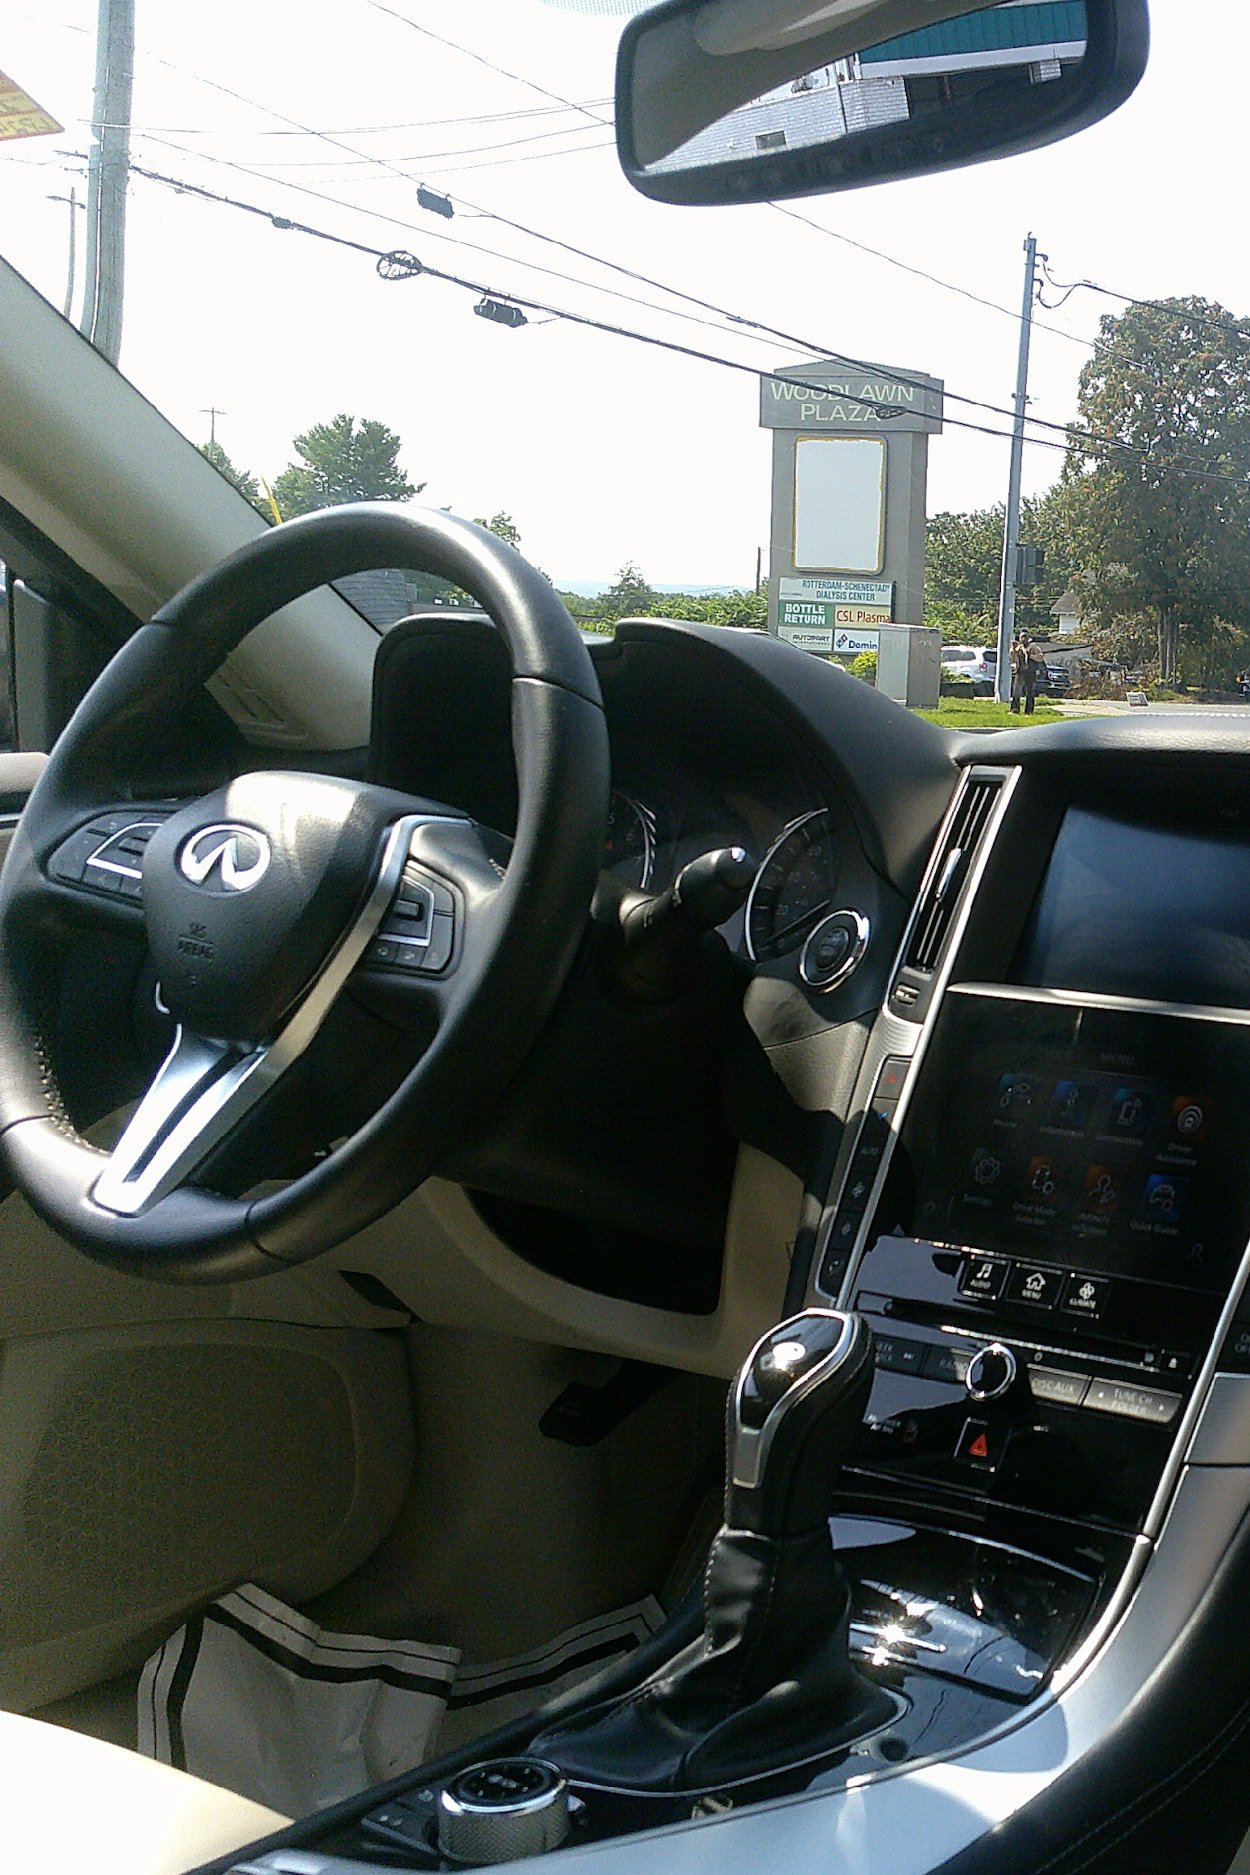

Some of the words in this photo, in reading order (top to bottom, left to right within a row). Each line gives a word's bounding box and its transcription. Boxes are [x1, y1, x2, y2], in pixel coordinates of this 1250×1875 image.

[770, 381, 914, 402] WOODLAWN
[800, 403, 881, 421] PLAZA
[816, 590, 847, 600] DIALYSIS
[848, 592, 875, 601] CENTER
[785, 603, 826, 614] BOTTLE
[784, 613, 826, 625] RETURN
[836, 610, 855, 622] CSL
[857, 611, 891, 624] Plasma
[848, 640, 878, 650] Domin
